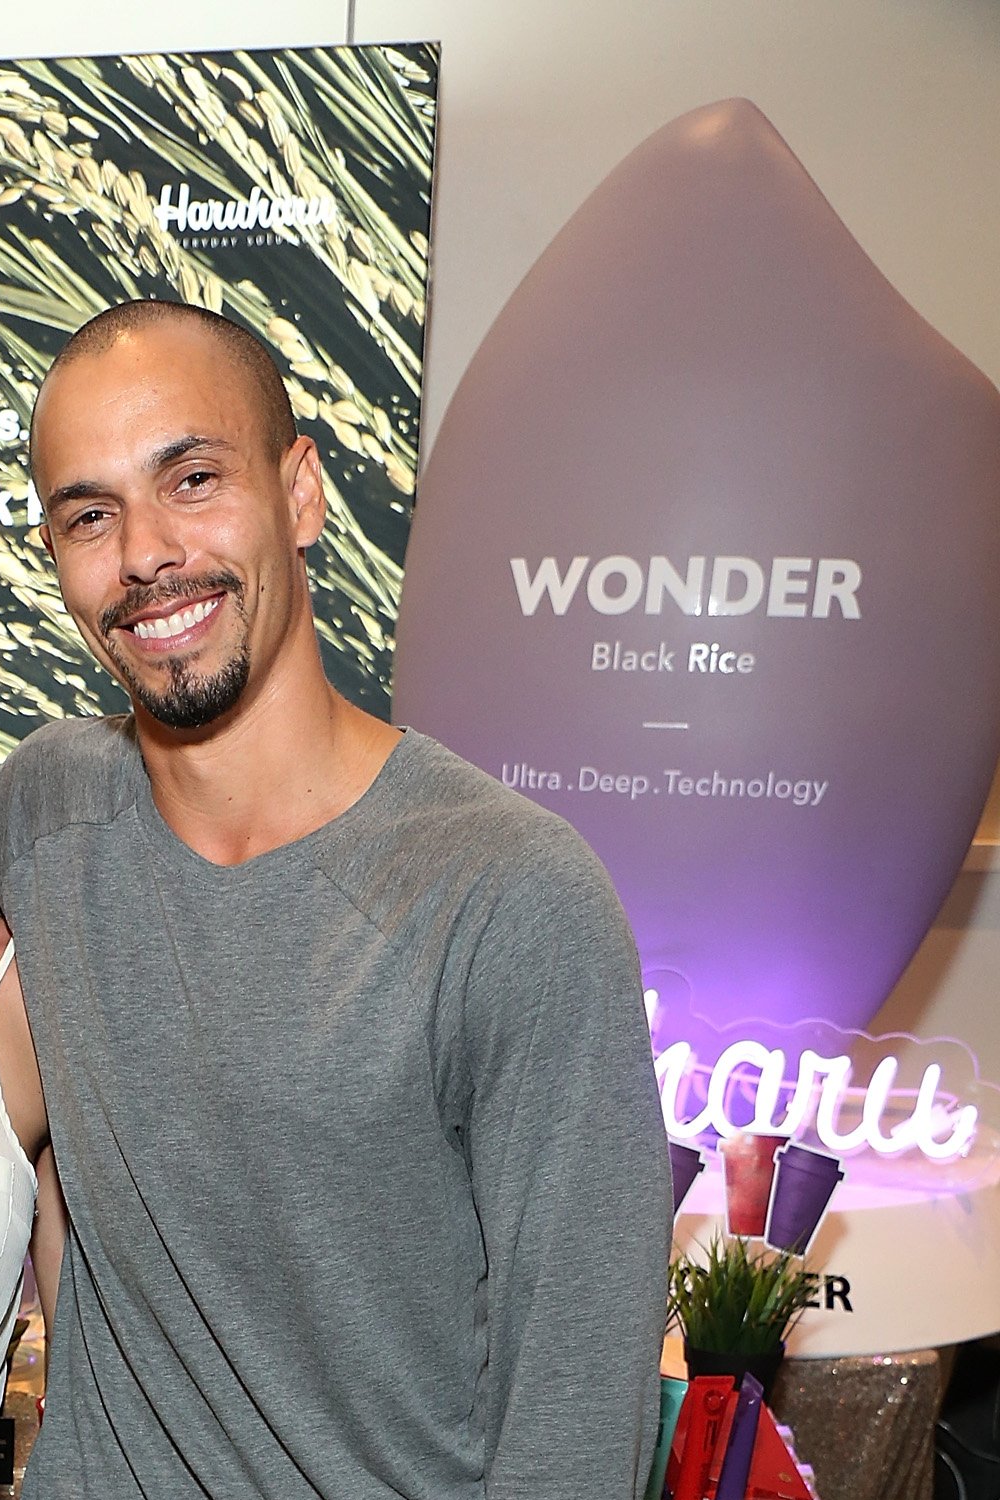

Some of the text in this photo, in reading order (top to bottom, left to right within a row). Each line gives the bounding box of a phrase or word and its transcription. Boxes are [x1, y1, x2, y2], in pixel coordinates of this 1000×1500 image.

[154, 183, 337, 232] Haruharu
[509, 556, 863, 620] WONDER
[592, 642, 757, 675] Black Rice
[663, 769, 829, 807] Technology
